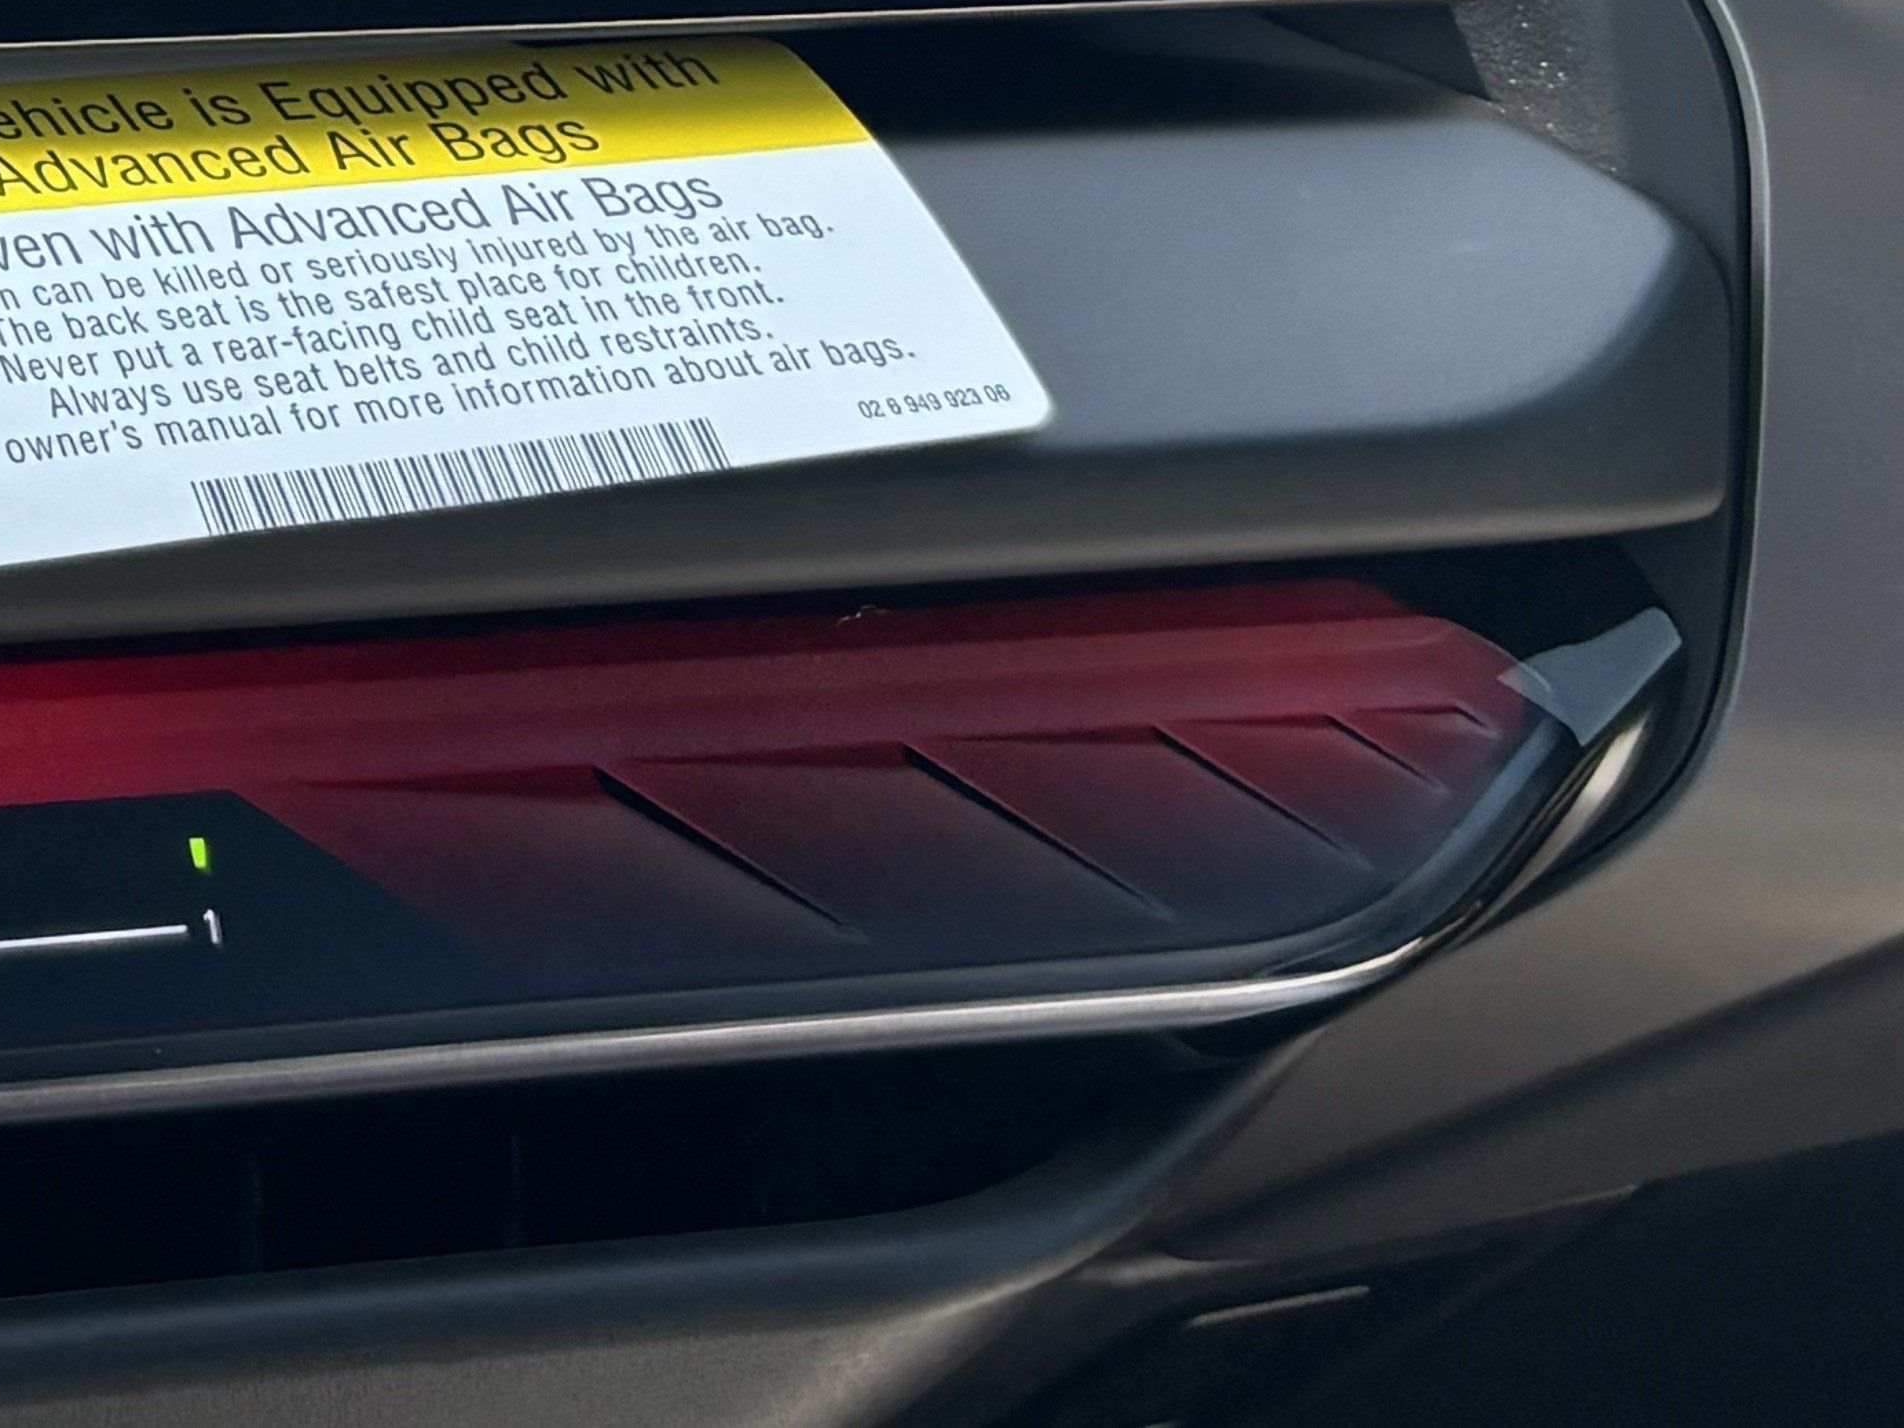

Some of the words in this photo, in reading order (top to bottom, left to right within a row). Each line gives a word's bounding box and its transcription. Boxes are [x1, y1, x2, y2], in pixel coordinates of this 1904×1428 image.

[181, 86, 252, 128] is
[256, 60, 569, 126] Equipped
[575, 49, 720, 96] with
[325, 127, 416, 171] Air
[425, 119, 600, 164] Bags
[31, 279, 94, 306] can
[99, 271, 146, 300] be
[151, 259, 250, 296] killed
[258, 260, 294, 285] or
[305, 241, 458, 280] seriously
[464, 229, 589, 268] injured
[593, 226, 638, 256] by
[643, 222, 700, 249] the
[707, 215, 750, 243] air
[755, 212, 834, 239] bag.
[88, 209, 215, 261] with
[226, 186, 492, 250] Advanced
[500, 181, 575, 226] Air
[579, 176, 723, 220] Bags
[60, 304, 149, 339] back
[155, 297, 231, 331] seat
[233, 294, 271, 323] is
[276, 288, 334, 319] the
[343, 275, 450, 312] safest
[455, 270, 547, 306] place
[552, 262, 602, 291] for
[613, 248, 761, 284] children.
[111, 339, 173, 380] put
[180, 342, 203, 367] a
[211, 319, 402, 364] rear-facing
[410, 304, 496, 342] child
[503, 298, 578, 331] seat
[579, 294, 619, 323] in
[623, 289, 681, 318] the
[686, 278, 784, 311] front.
[3, 418, 143, 464] owner's
[152, 404, 282, 446] manual
[288, 401, 341, 432] for
[352, 390, 445, 424] more
[450, 364, 656, 412] information
[662, 348, 764, 385] about
[767, 342, 811, 373] air
[818, 337, 916, 367] bags.
[48, 382, 172, 419] Always
[181, 375, 243, 404] use
[252, 362, 329, 399] seat
[332, 353, 422, 388] belts
[431, 340, 496, 377] and
[505, 330, 590, 367] child
[598, 316, 773, 357] restraints.
[203, 909, 220, 944] 1
